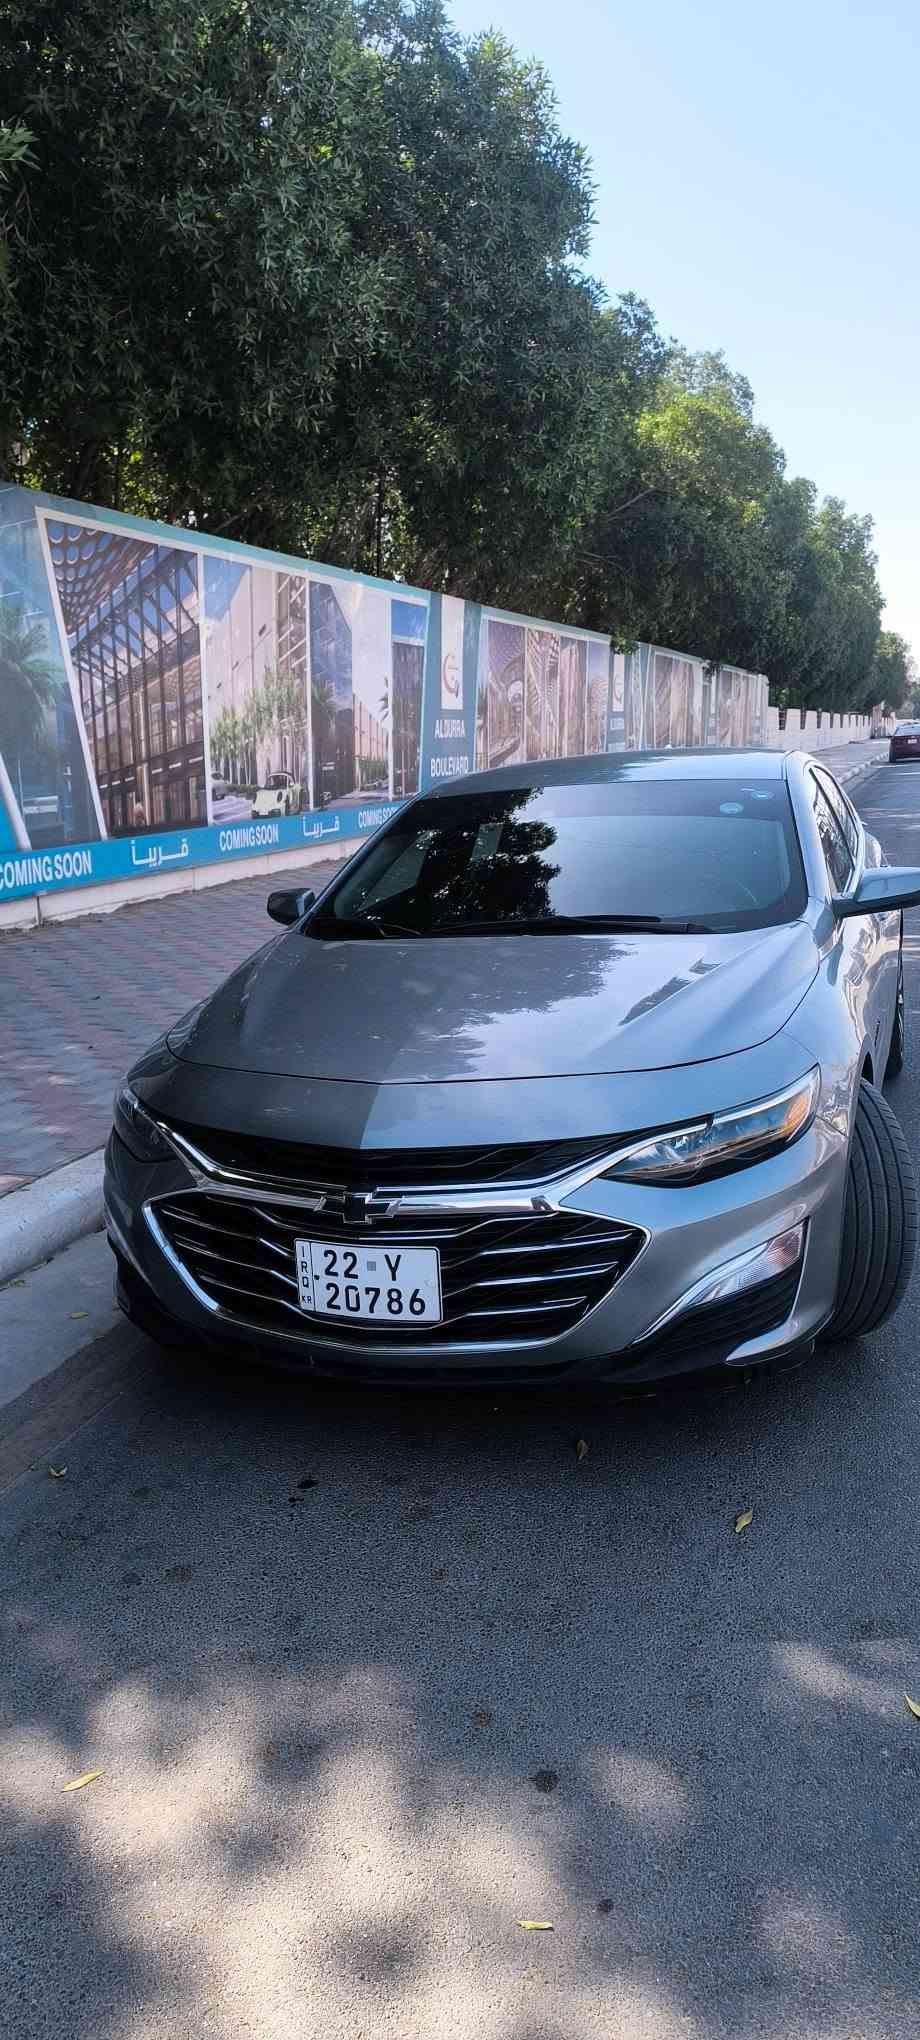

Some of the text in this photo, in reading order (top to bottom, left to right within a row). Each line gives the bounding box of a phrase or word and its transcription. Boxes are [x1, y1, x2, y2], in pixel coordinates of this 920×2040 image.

[430, 756, 470, 777] BOULEVARD
[382, 806, 400, 823] SO
[219, 823, 279, 851] COMING SOON
[54, 849, 92, 880] SOON
[323, 1249, 402, 1282] 22 Y
[326, 1282, 426, 1316] 20786
